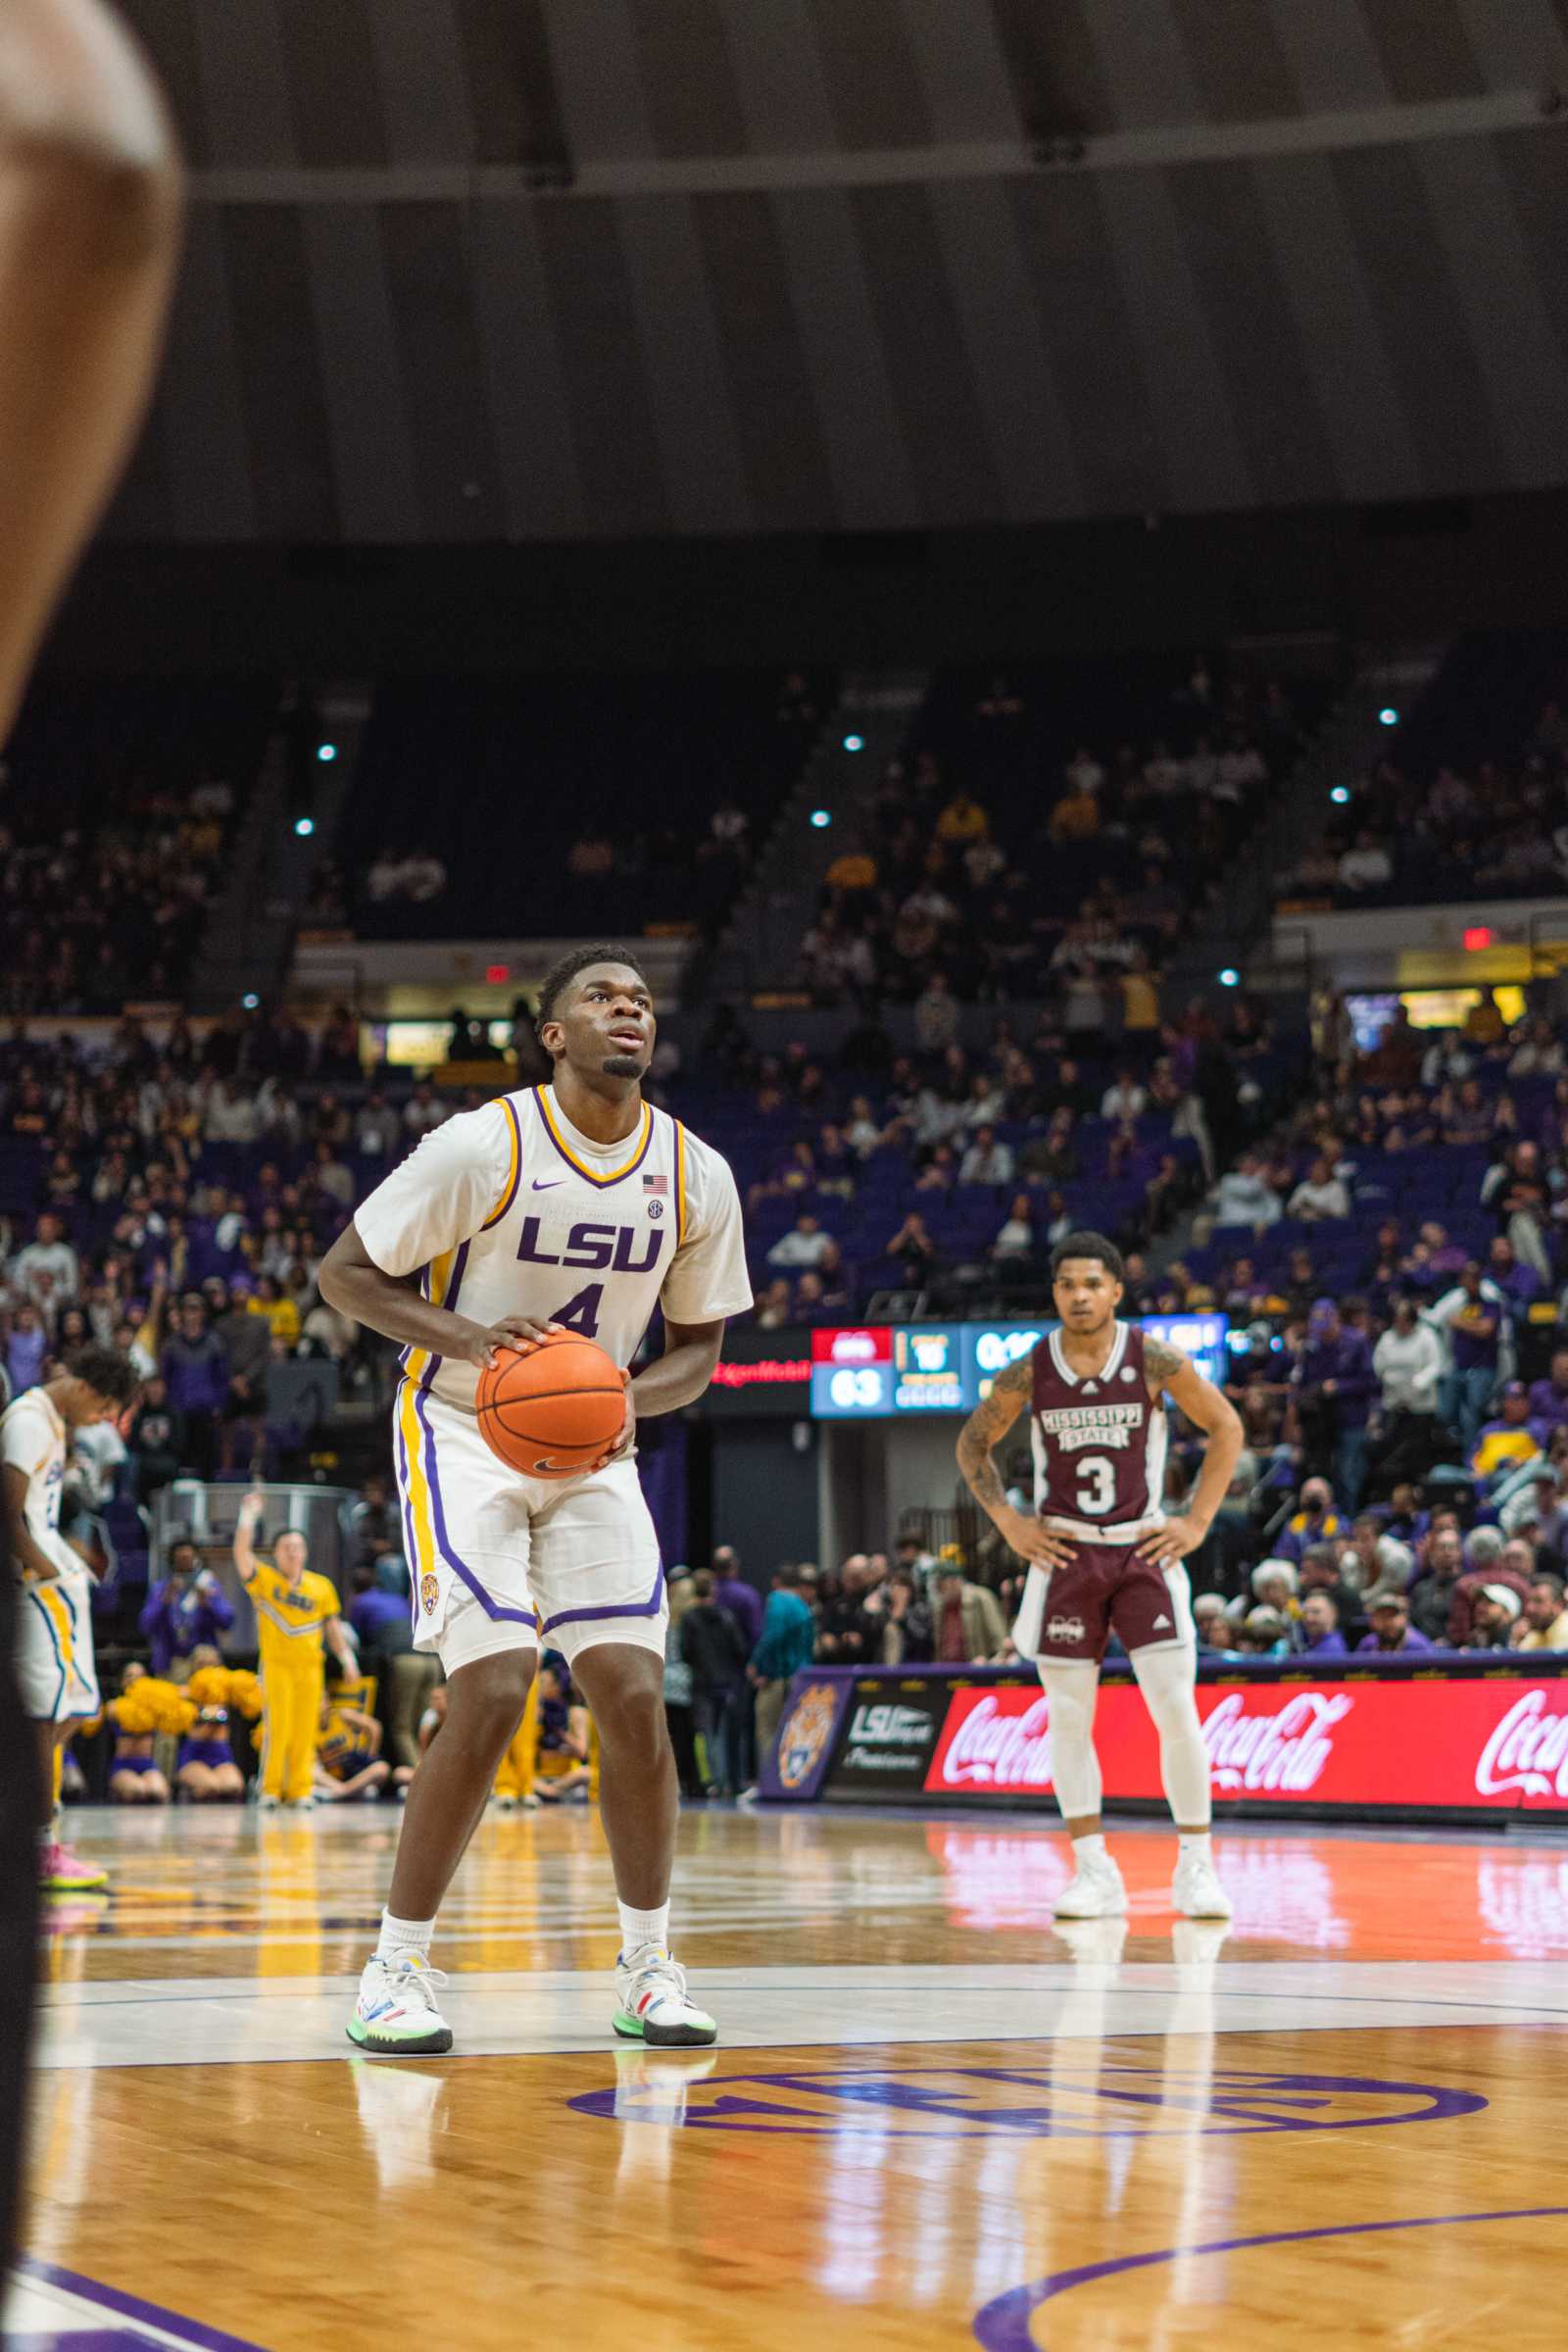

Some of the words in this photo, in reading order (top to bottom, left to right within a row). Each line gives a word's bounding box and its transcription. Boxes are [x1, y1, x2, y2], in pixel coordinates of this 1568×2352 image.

[516, 1216, 664, 1273] LSU
[548, 1283, 604, 1339] 4
[830, 1369, 881, 1408] 63
[1042, 1404, 1142, 1433] MISSISSIPPI
[1067, 1428, 1115, 1445] STATE
[1076, 1456, 1115, 1514] 3
